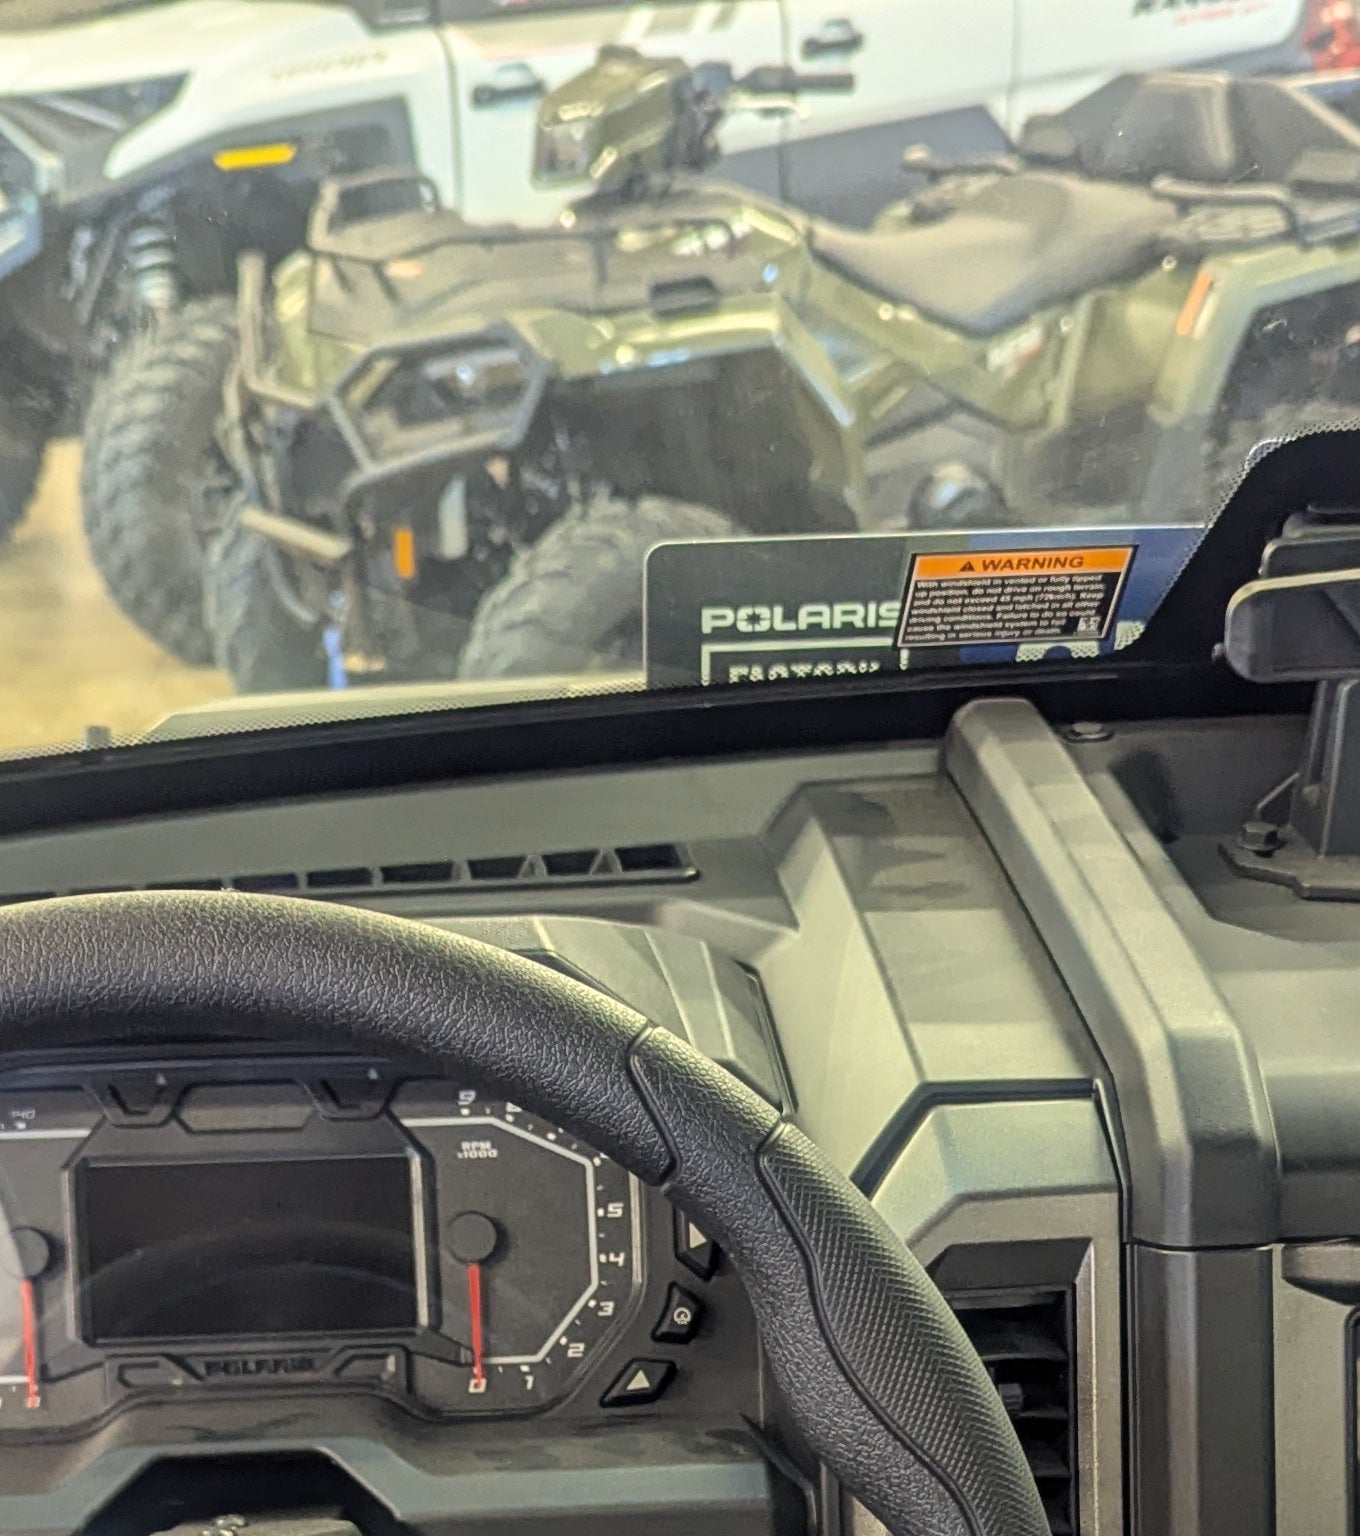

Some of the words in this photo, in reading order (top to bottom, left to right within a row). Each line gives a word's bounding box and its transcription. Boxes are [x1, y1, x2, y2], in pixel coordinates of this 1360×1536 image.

[981, 556, 1085, 572] WARNING
[700, 600, 902, 634] POLARIS
[460, 1140, 492, 1151] RPM
[606, 1202, 625, 1218] 5
[608, 1252, 625, 1267] 4
[597, 1301, 615, 1317] 3
[566, 1342, 586, 1358] 2
[468, 1377, 487, 1394] 0
[524, 1375, 535, 1390] 1
